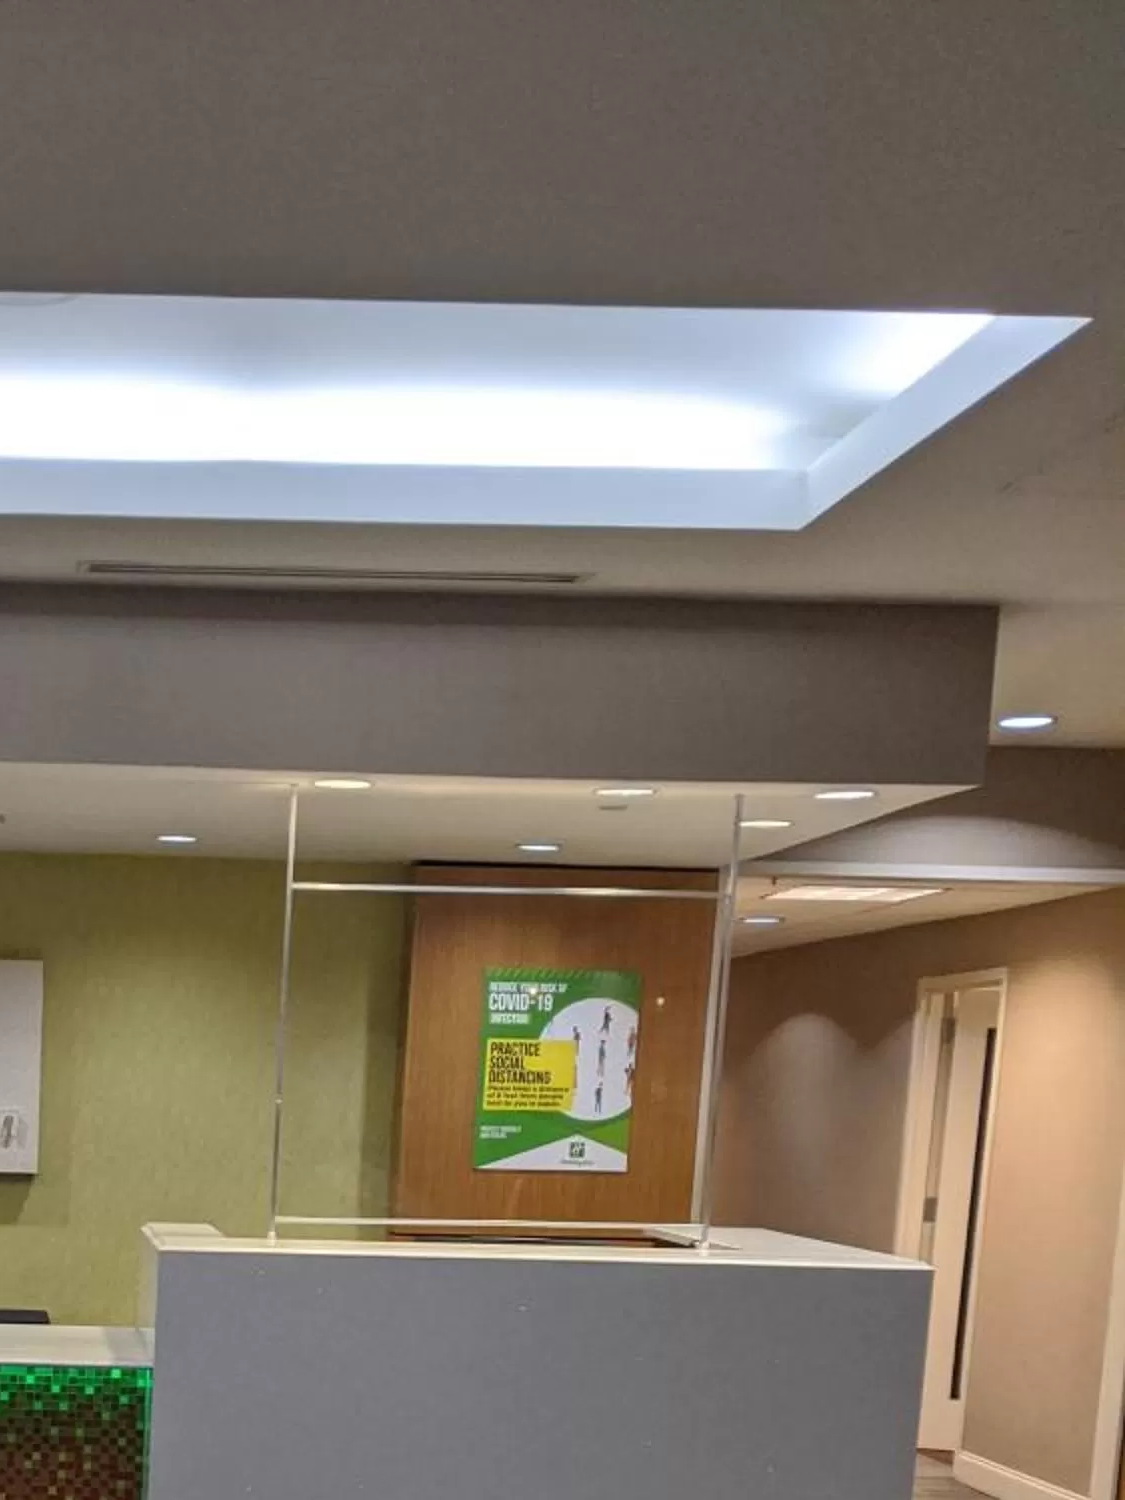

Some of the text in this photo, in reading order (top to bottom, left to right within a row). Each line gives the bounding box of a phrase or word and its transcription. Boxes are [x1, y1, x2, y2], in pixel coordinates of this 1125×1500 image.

[489, 993, 554, 1012] COVID-19
[490, 1041, 542, 1057] PRACTICE
[490, 1055, 525, 1070] SOCIAL
[488, 1070, 553, 1085] DISTANCING
